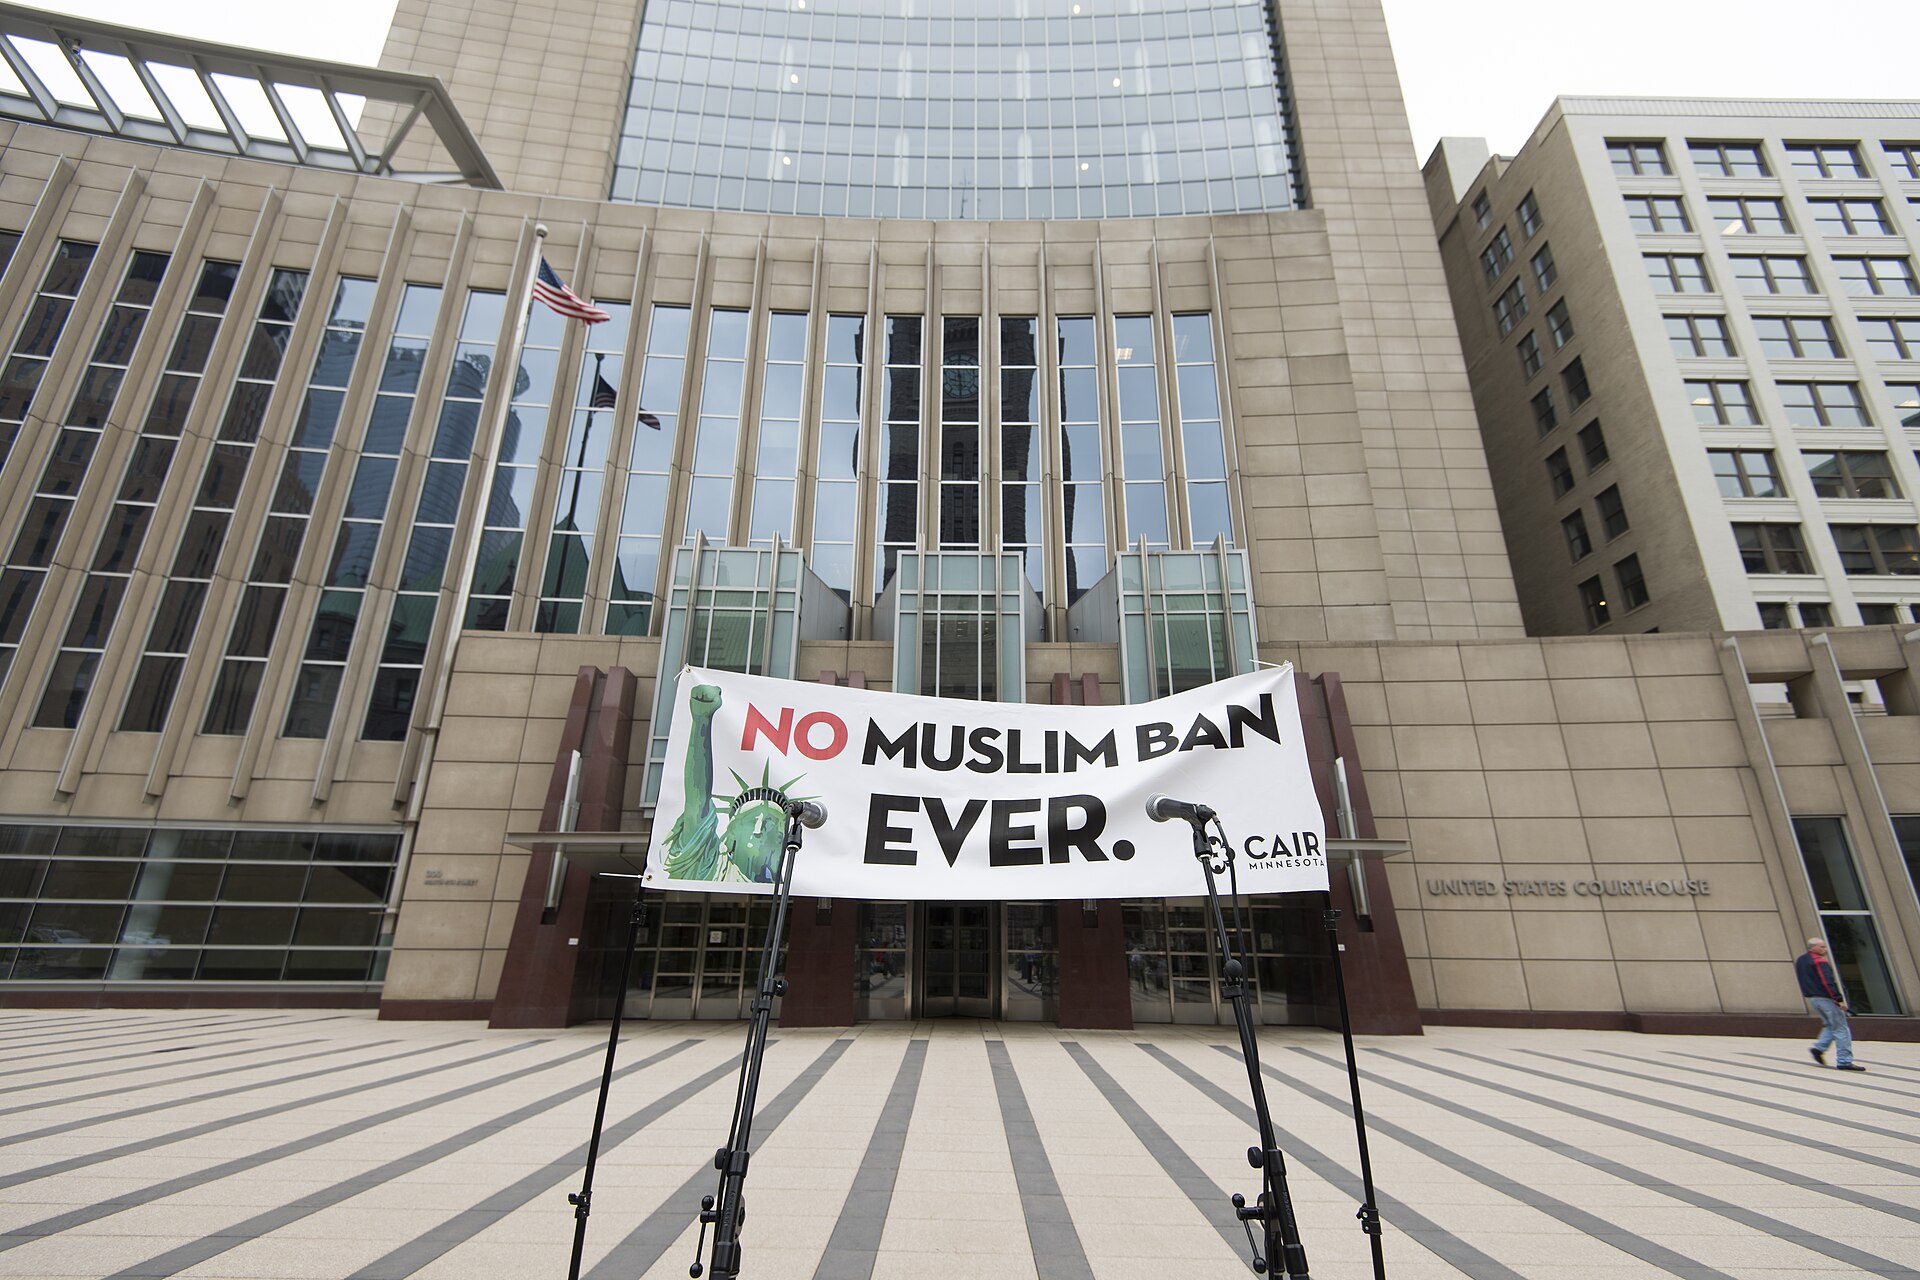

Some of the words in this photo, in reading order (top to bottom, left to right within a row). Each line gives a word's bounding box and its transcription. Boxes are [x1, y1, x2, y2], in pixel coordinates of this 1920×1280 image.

[741, 703, 848, 761] NO
[862, 716, 1119, 774] MUSLIM
[1135, 692, 1282, 763] BAN
[863, 792, 1136, 868] EVER.
[1244, 831, 1322, 860] CAIR
[1426, 879, 1498, 896] UNITED
[1503, 879, 1568, 897] STATES
[1573, 879, 1711, 897] COURTHOUSE
